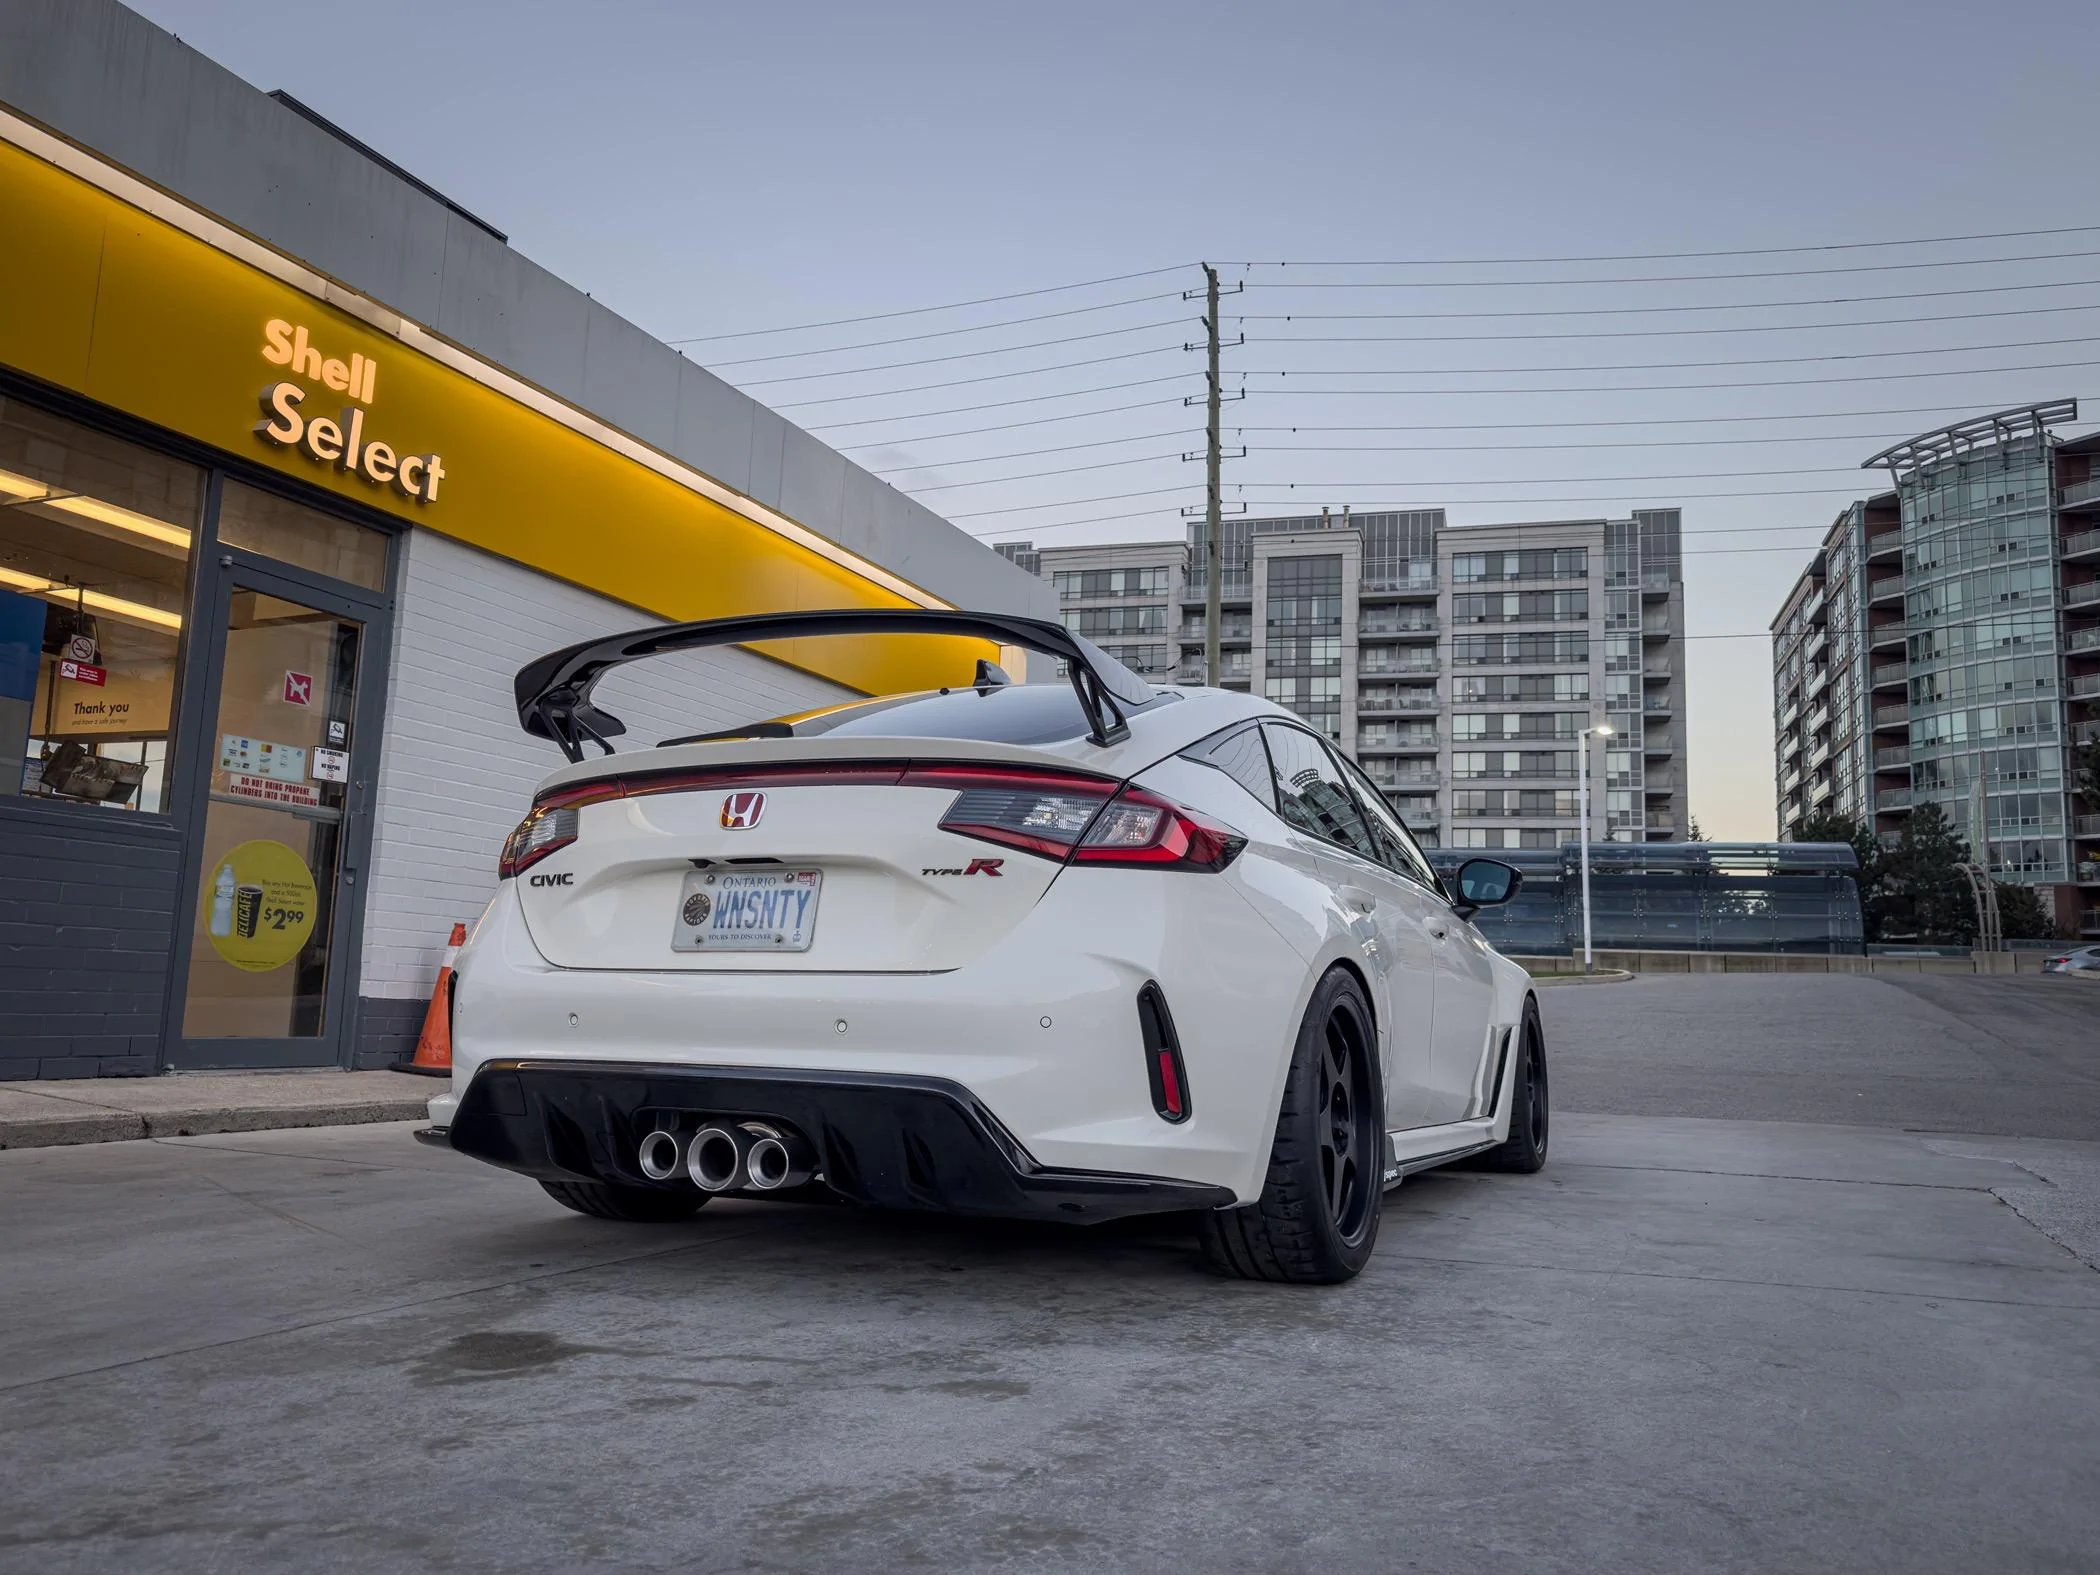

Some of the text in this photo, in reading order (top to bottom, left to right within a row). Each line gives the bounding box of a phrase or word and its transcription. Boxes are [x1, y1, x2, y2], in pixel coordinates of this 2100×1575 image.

[262, 318, 377, 405] Shell
[259, 381, 446, 502] Select
[74, 700, 130, 716] Thank you
[230, 785, 317, 806] CYLINDERS INTO THE BUILDING
[241, 777, 310, 796] DO NOT BRING PROPANE
[922, 858, 1004, 877] TYPE R
[530, 873, 574, 887] CIVIC
[723, 876, 777, 889] ONTARIO
[713, 890, 811, 929] WNSNTY
